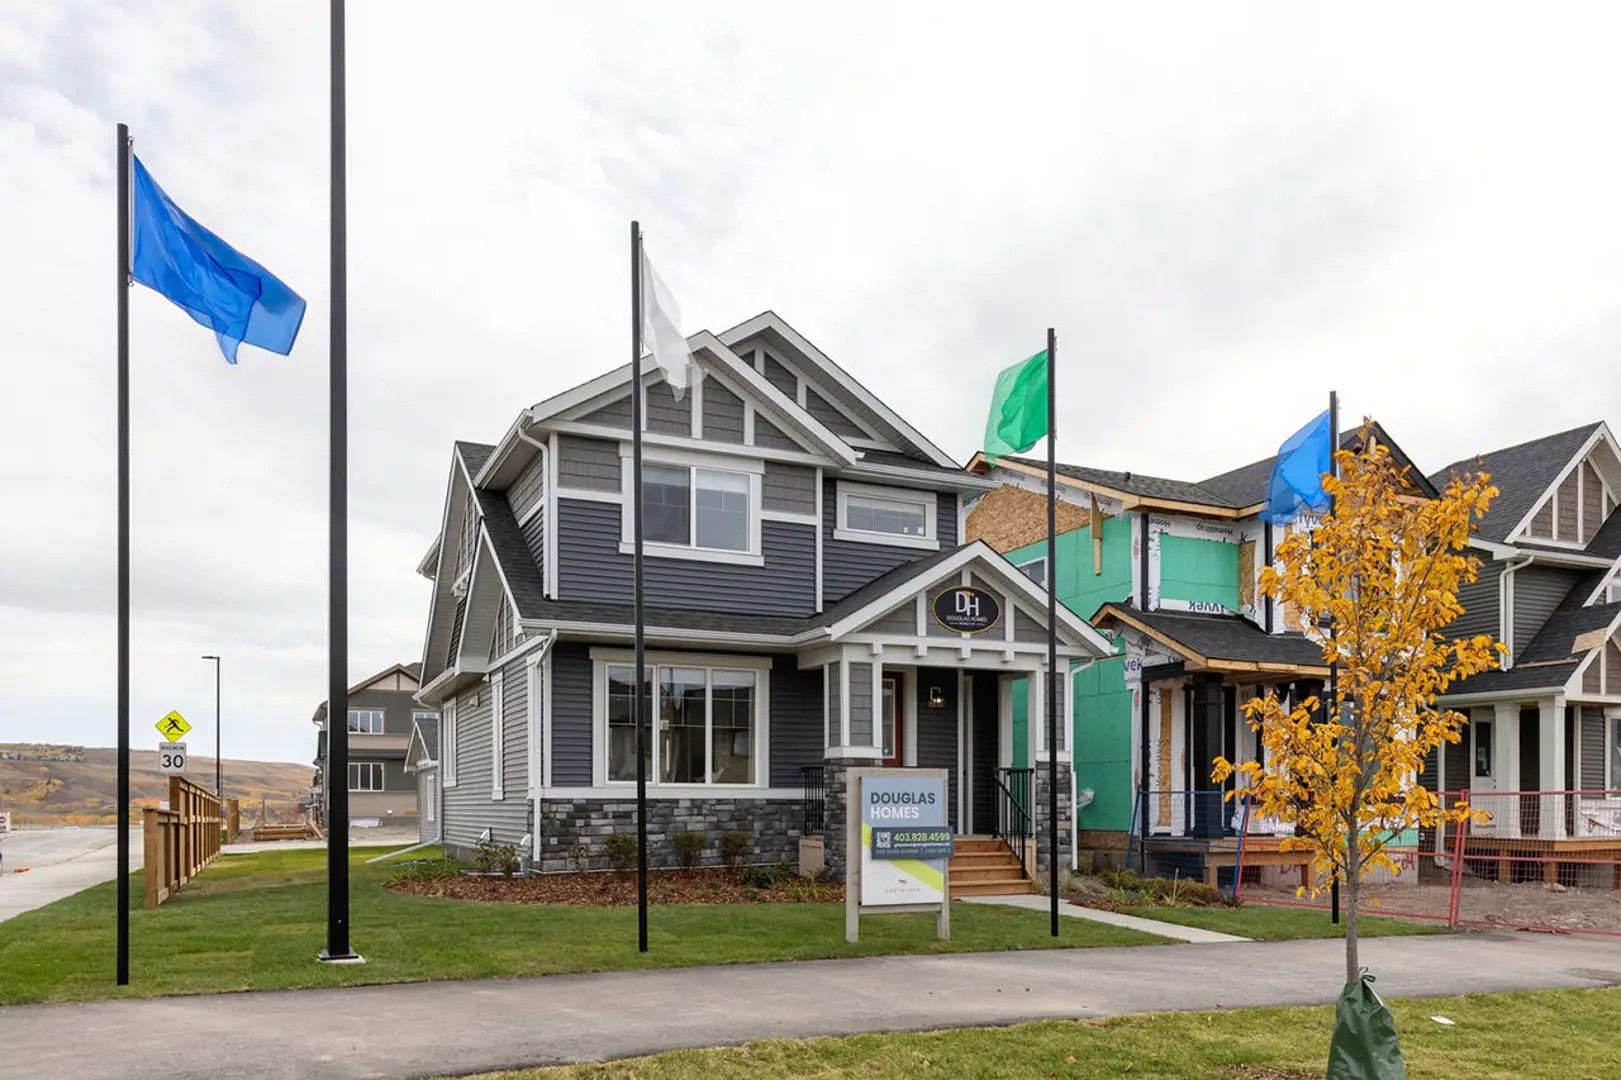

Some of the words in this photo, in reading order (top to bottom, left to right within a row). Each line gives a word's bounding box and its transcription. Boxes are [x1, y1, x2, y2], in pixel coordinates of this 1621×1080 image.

[162, 754, 184, 768] 30
[870, 792, 936, 805] DOUGLAS
[870, 806, 920, 820] HOMES
